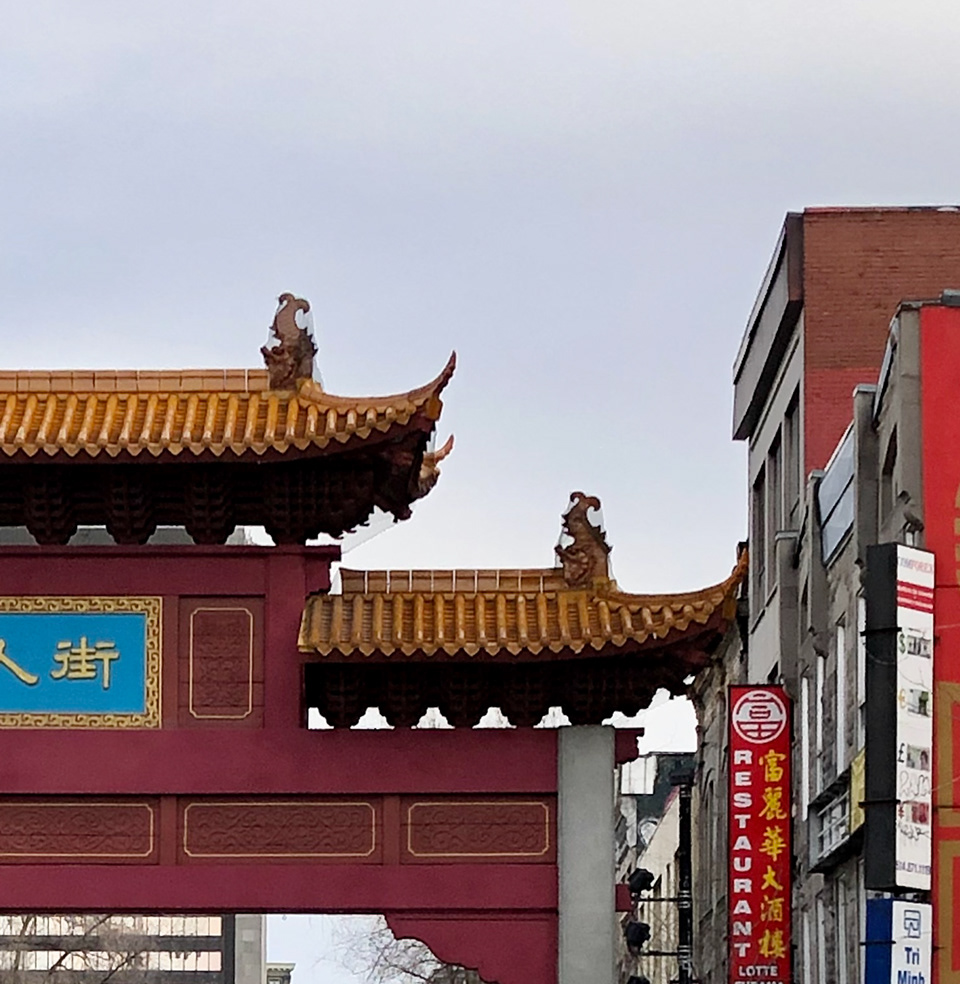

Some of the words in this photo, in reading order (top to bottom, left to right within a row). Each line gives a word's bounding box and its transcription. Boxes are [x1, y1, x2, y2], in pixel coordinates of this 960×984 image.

[733, 749, 753, 958] RESTAURANT
[758, 749, 788, 959] 富麗華大酒樓
[738, 965, 778, 977] LOTTE
[904, 947, 920, 965] Tri
